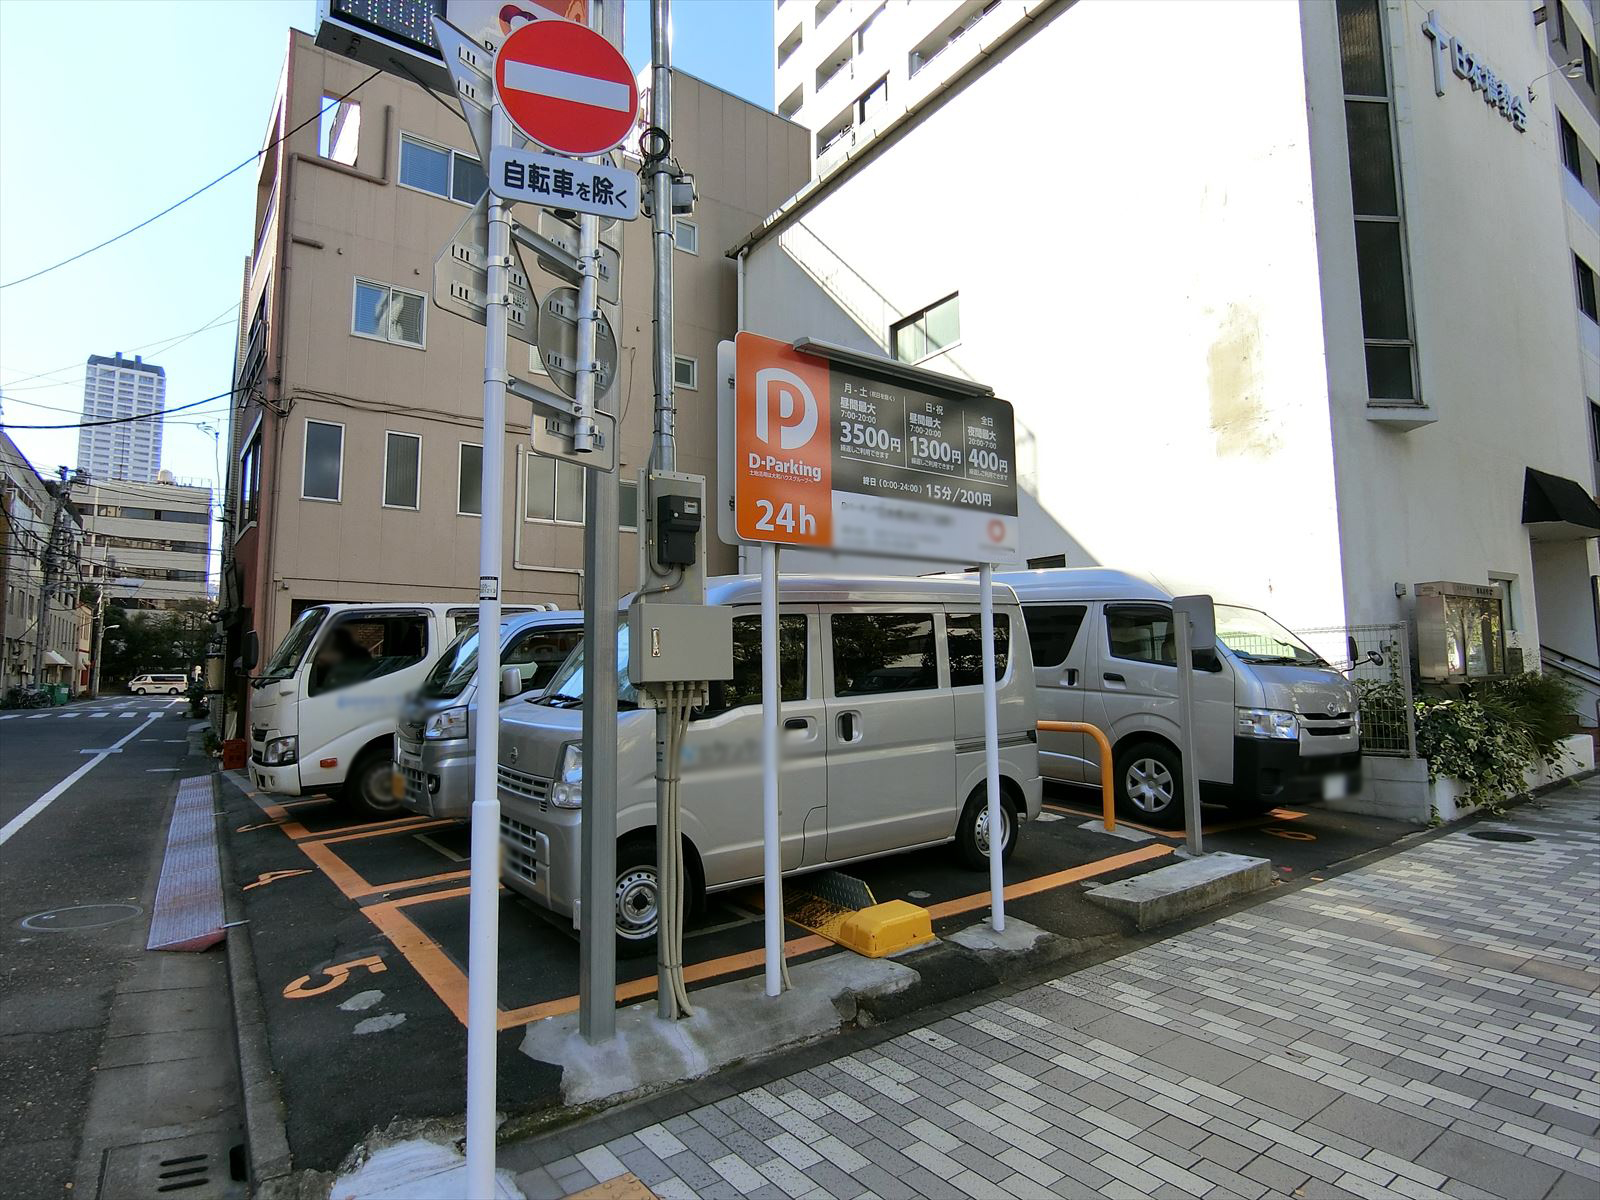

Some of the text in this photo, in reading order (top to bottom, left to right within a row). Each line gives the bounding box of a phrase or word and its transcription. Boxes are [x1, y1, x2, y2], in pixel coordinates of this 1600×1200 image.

[503, 159, 628, 209] 自転車を除く
[840, 396, 876, 415] 昼間最大
[909, 412, 942, 429] 昼間最大
[840, 421, 901, 453] 3500円
[910, 436, 962, 465] 1300円
[748, 452, 822, 482] D-Parking
[968, 448, 1008, 473] 400円
[755, 499, 816, 536] 24h
[283, 955, 388, 1000] 5
